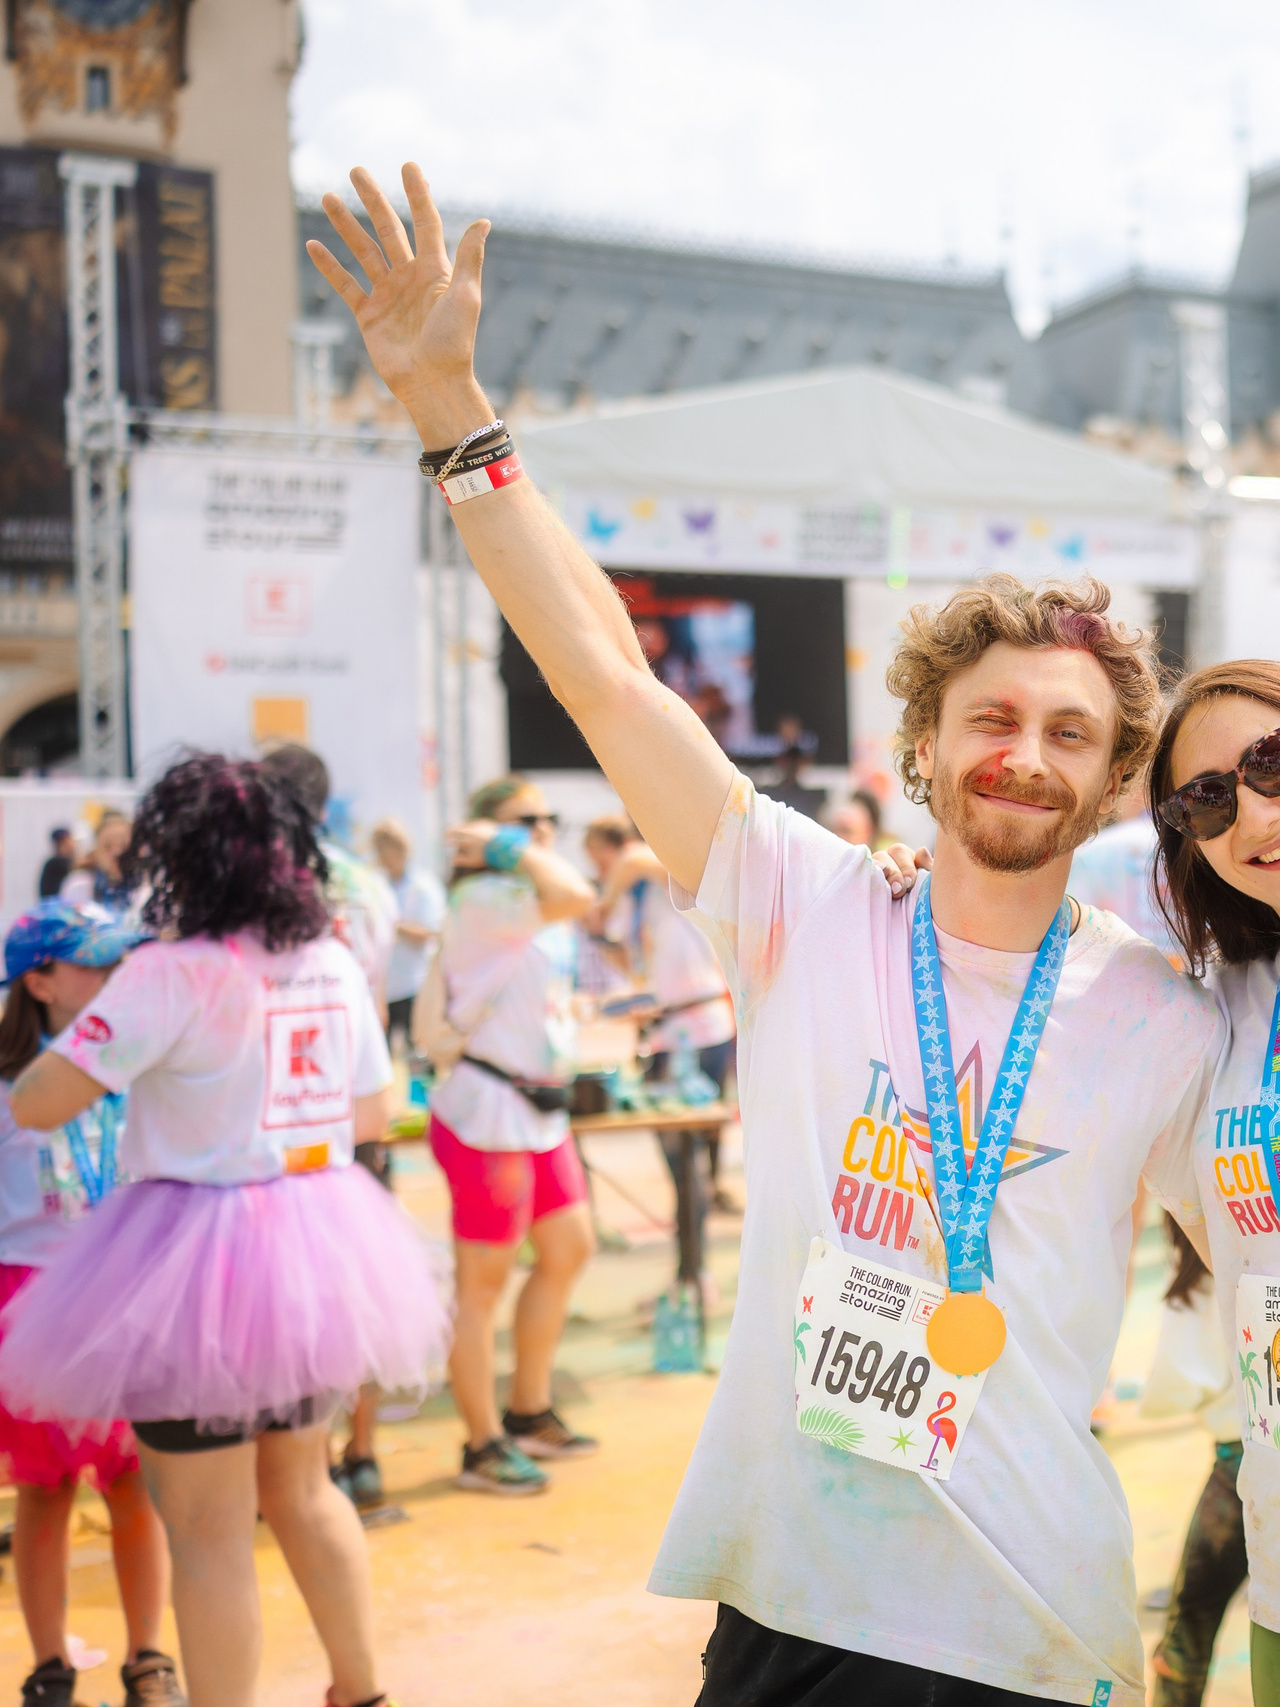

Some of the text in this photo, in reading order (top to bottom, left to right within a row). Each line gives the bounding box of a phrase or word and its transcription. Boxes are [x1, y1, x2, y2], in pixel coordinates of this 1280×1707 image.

[467, 453, 493, 466] TREES
[494, 444, 511, 457] WITH
[289, 1028, 323, 1079] K
[842, 1116, 933, 1199] COL
[831, 1174, 915, 1251] RUN
[849, 1265, 867, 1283] THE
[864, 1269, 895, 1292] COLOR
[1265, 1285, 1277, 1298] THE
[844, 1279, 906, 1312] amazing
[848, 1293, 878, 1314] tour
[810, 1325, 931, 1418] 15948
